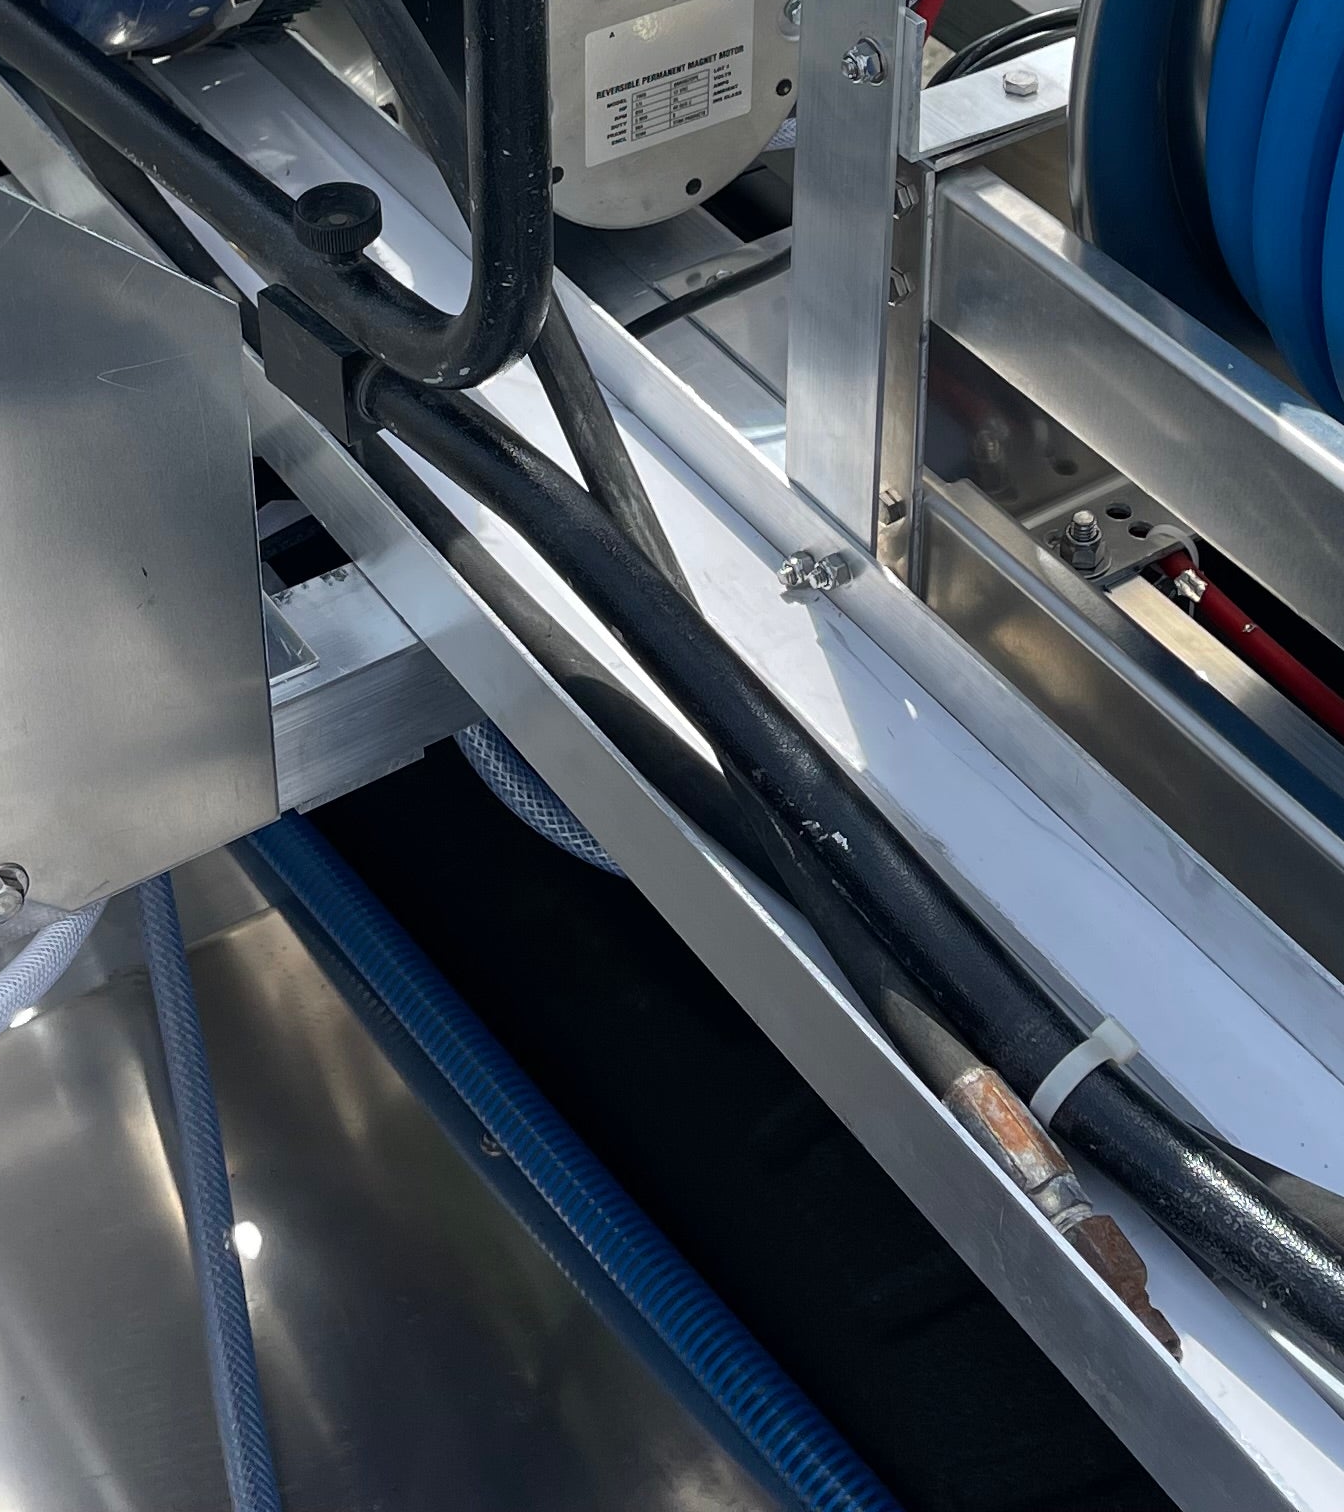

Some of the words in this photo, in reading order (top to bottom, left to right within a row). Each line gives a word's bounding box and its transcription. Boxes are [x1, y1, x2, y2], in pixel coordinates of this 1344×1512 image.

[609, 31, 616, 39] A
[596, 78, 641, 100] REVERSIBLE
[642, 63, 686, 85] PERMANENT
[687, 53, 717, 69] MAGNET
[718, 45, 745, 60] MOTOR
